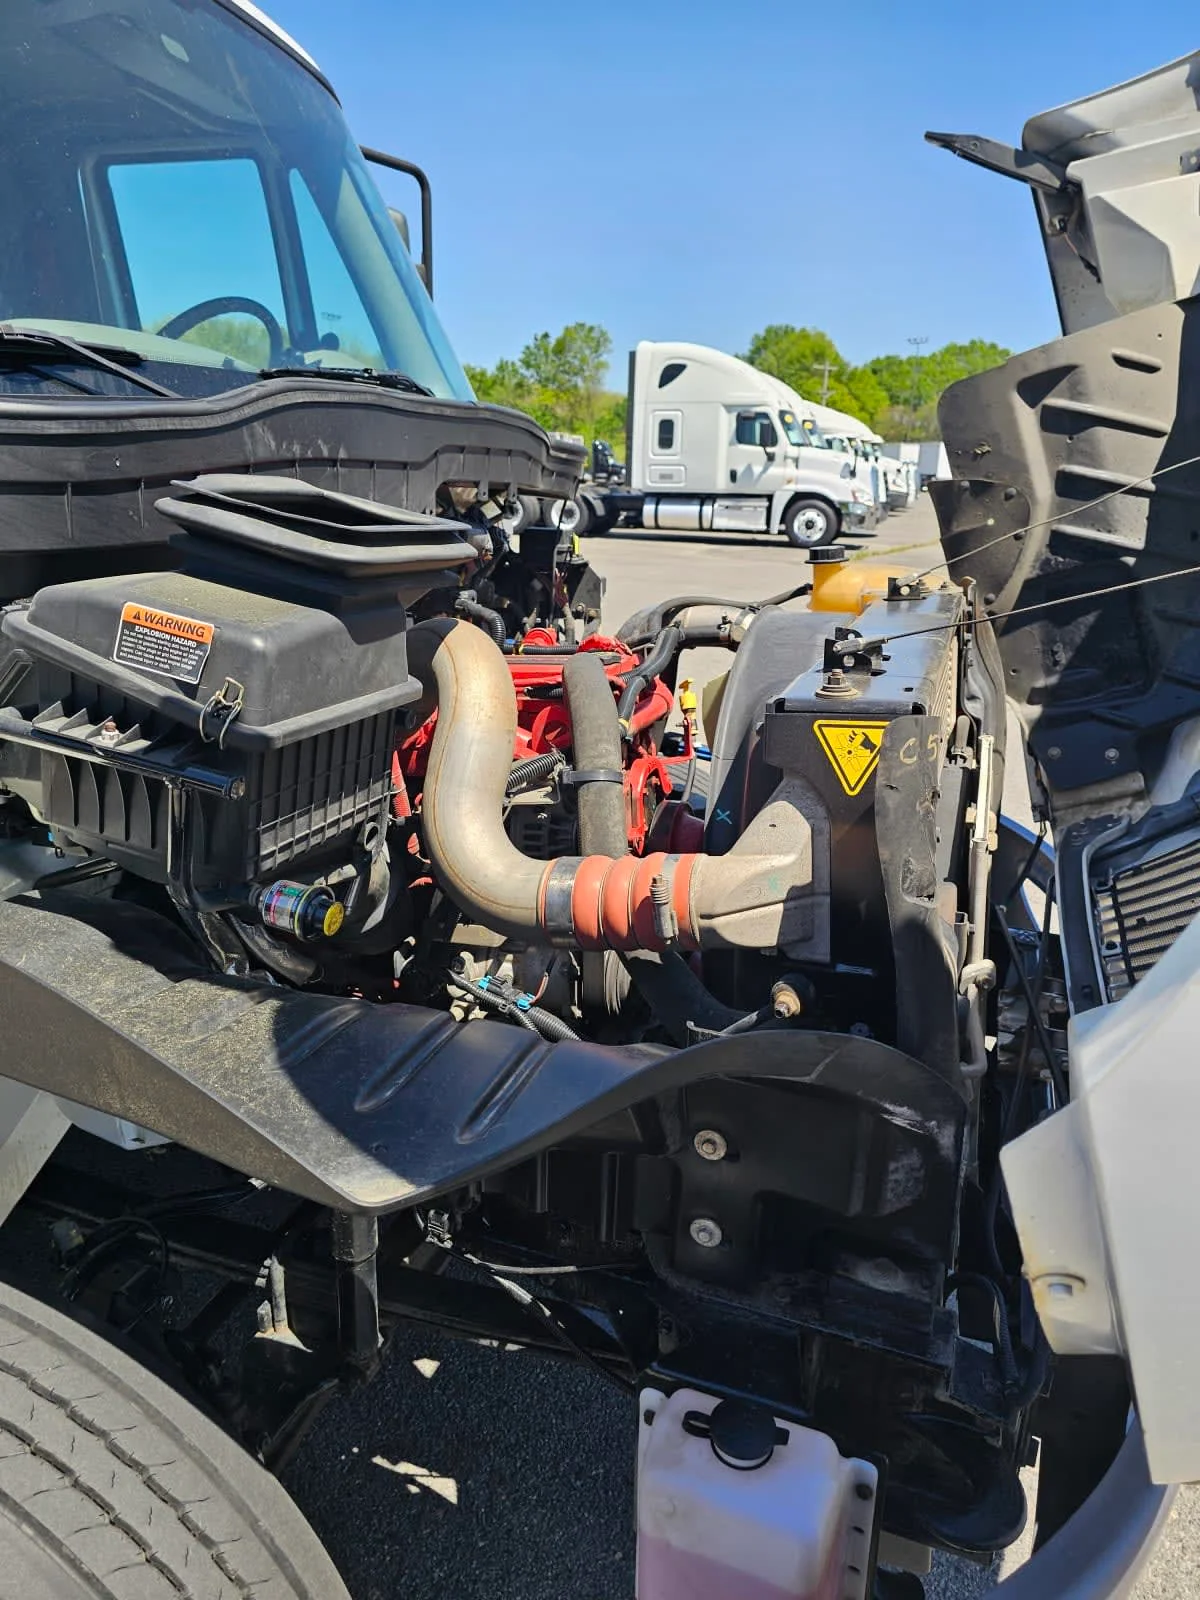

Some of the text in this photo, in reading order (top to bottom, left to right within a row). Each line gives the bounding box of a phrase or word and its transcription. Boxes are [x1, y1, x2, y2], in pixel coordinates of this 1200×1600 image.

[135, 626, 171, 641] EXPLOSION
[171, 636, 197, 648] HAZARD
[143, 612, 206, 639] WARNING
